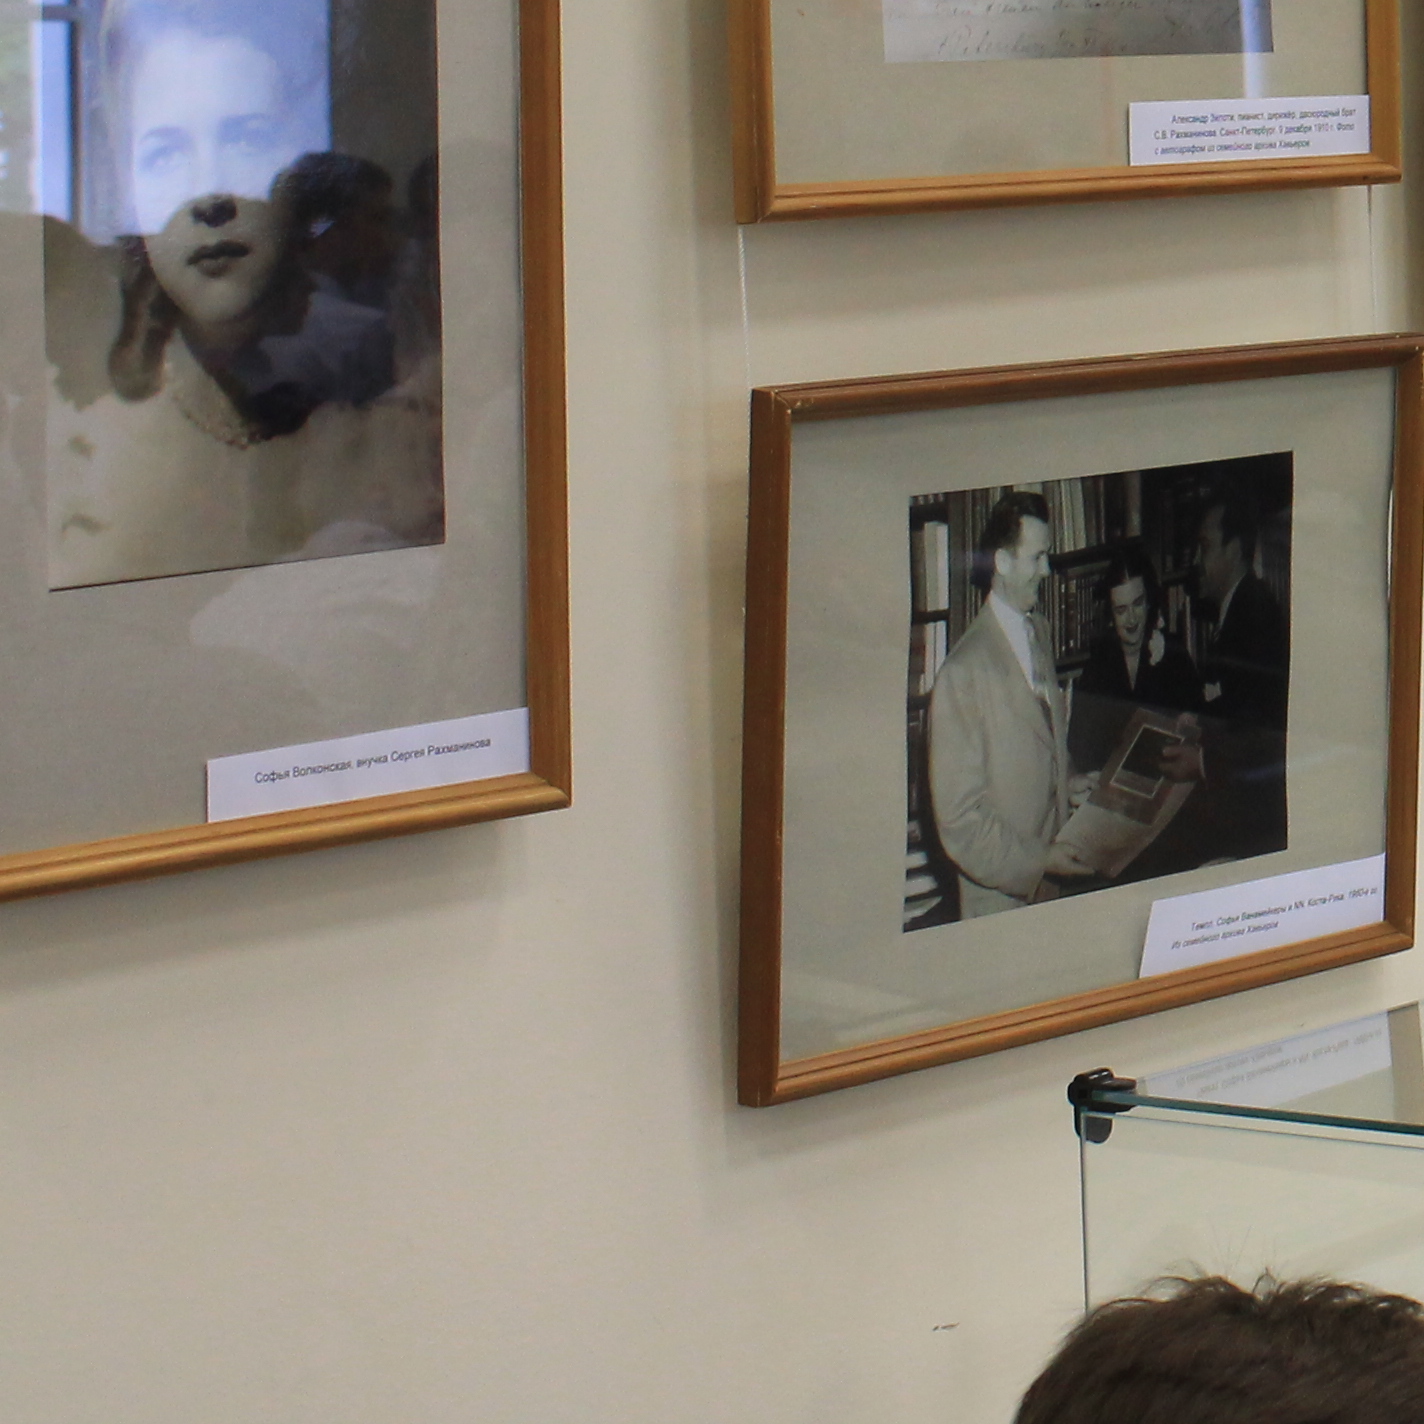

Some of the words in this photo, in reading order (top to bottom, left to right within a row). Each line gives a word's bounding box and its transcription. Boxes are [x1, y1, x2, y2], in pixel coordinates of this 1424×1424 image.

[255, 769, 291, 784] Софья
[356, 753, 389, 770] внучка
[390, 747, 426, 764] Сергея
[427, 736, 492, 757] Рахманинова
